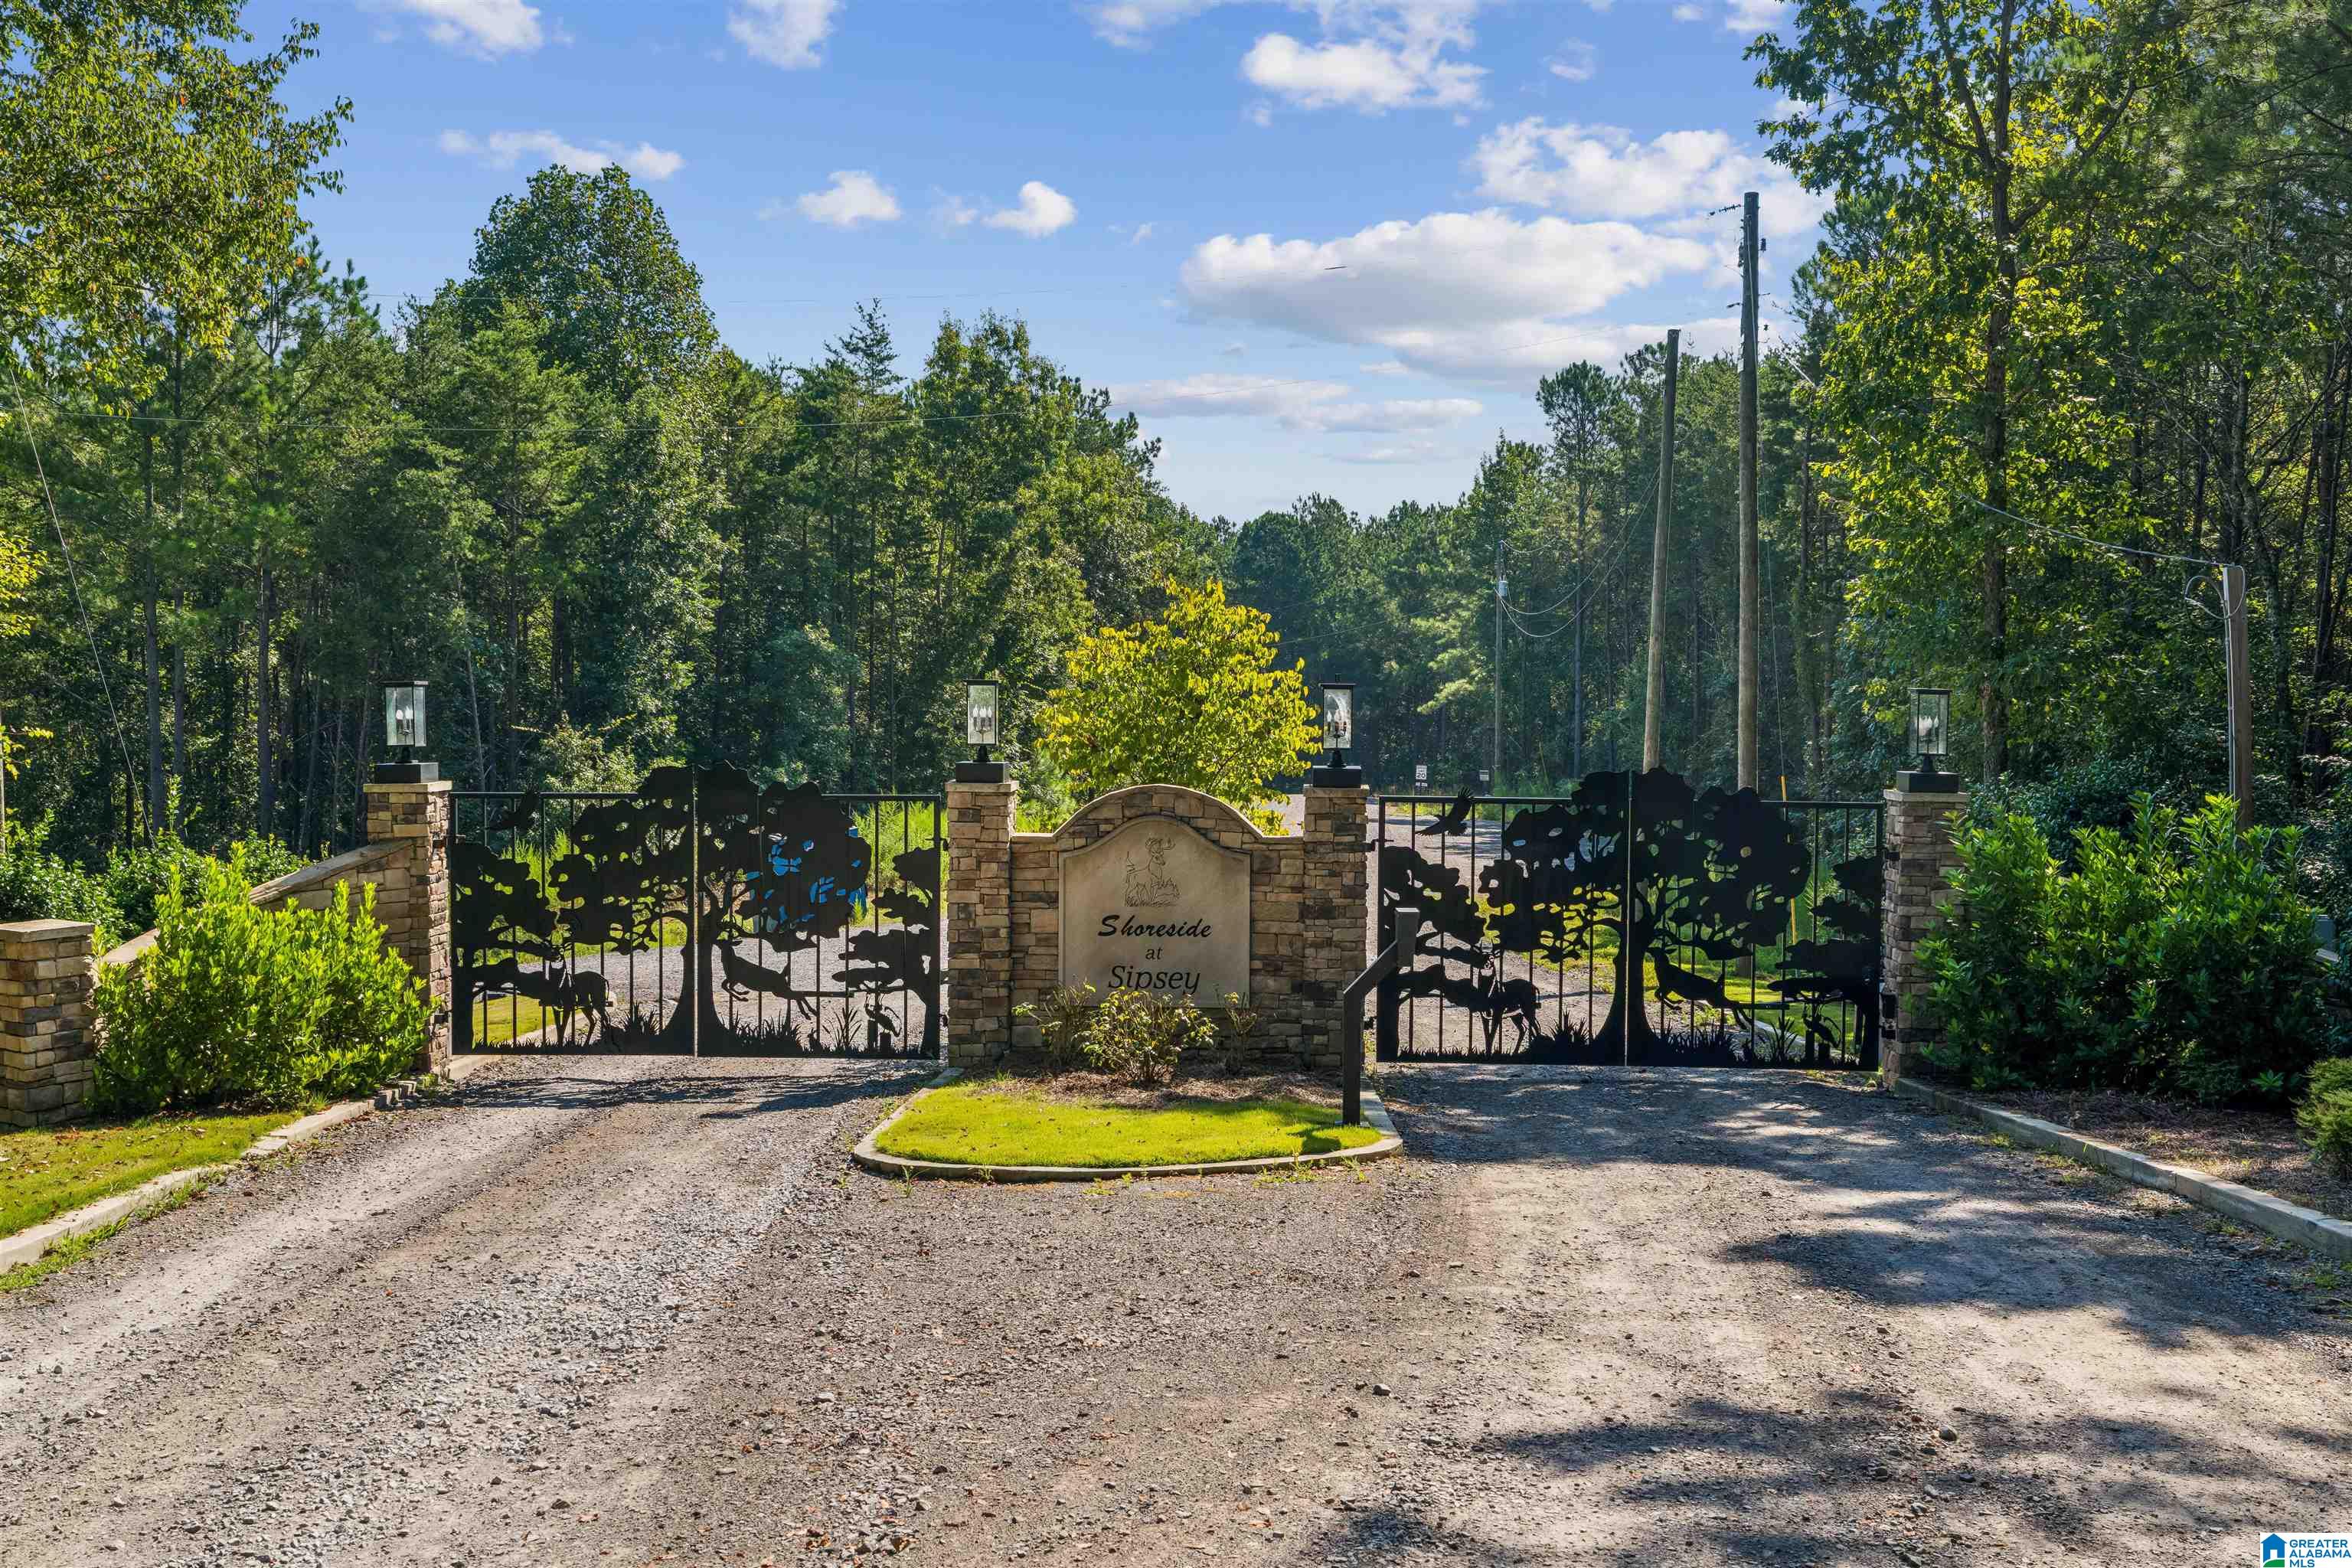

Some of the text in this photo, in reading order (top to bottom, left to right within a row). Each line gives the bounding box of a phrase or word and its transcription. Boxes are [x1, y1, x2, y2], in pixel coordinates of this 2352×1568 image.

[1098, 915, 1214, 938] Shoreside
[1145, 947, 1164, 960] at
[1108, 965, 1200, 995] Sipsey
